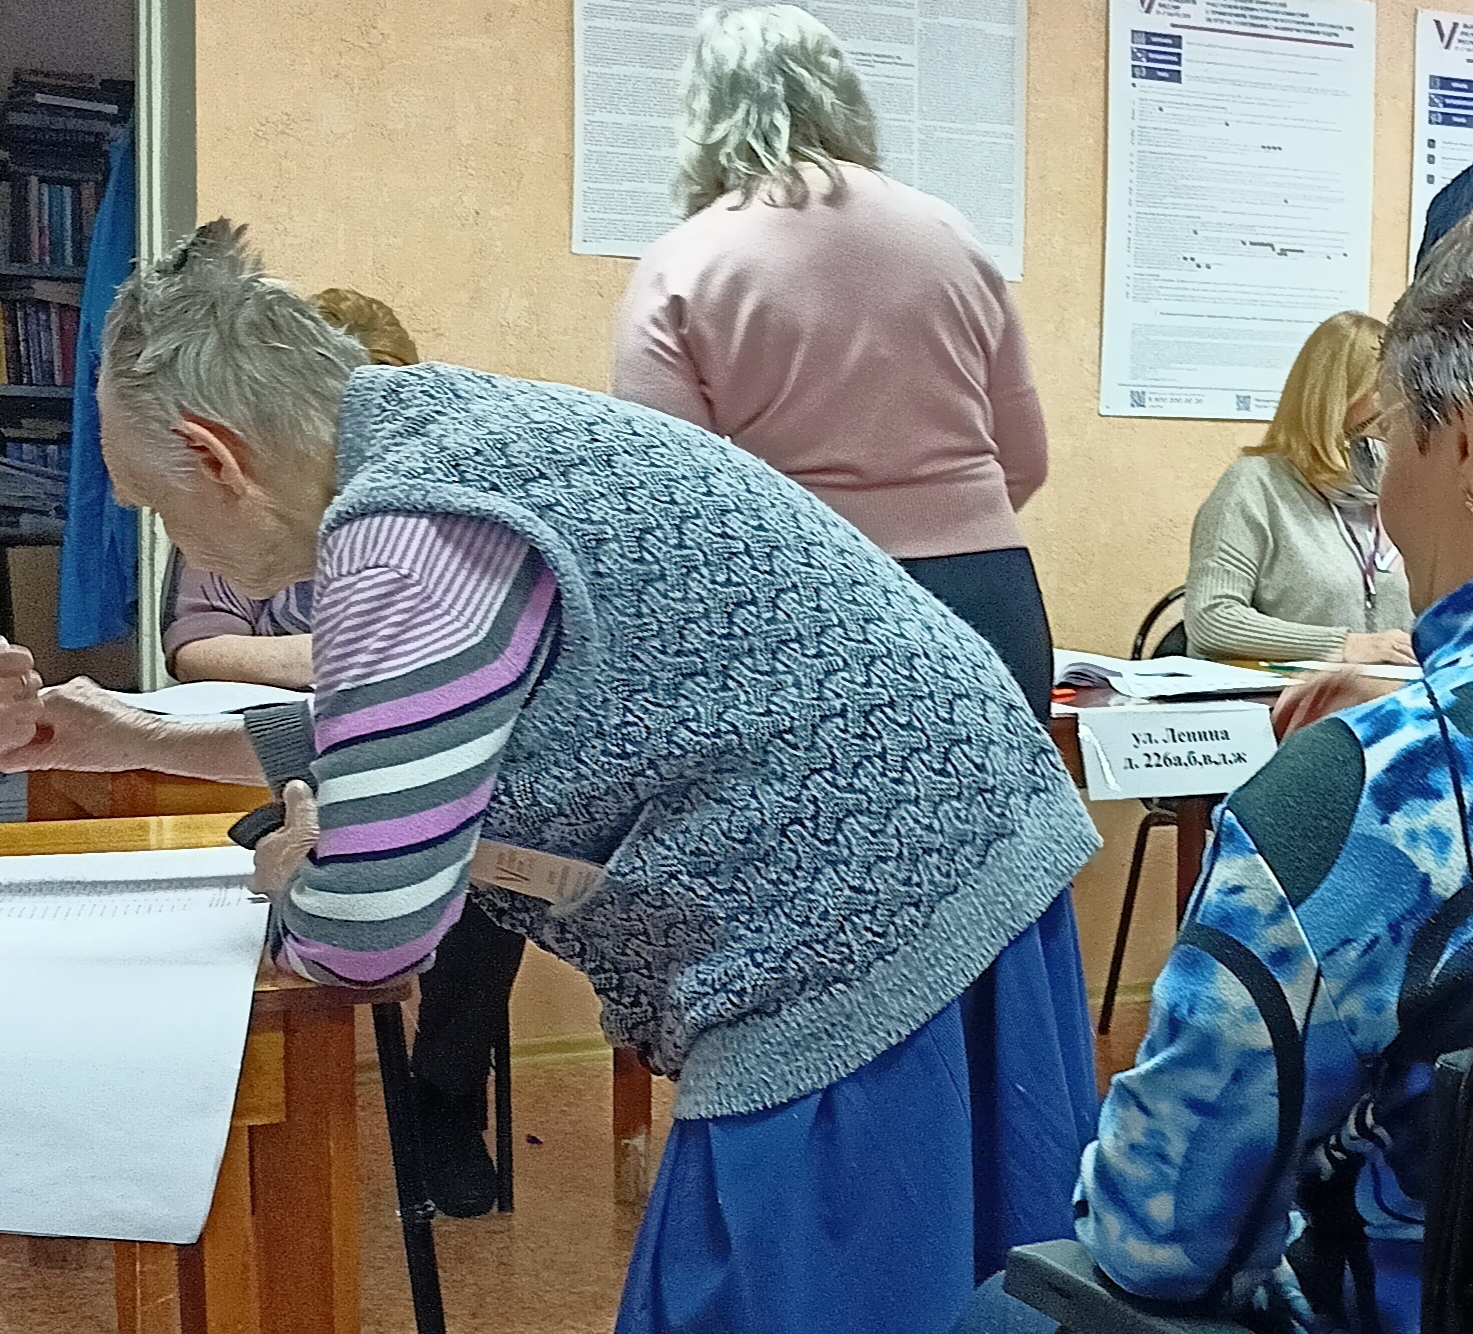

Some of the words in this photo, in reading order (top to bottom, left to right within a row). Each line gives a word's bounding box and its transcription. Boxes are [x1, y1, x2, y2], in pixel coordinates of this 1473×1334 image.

[1433, 19, 1459, 50] V
[1131, 733, 1159, 749] ул.
[1162, 727, 1230, 744] Ленина
